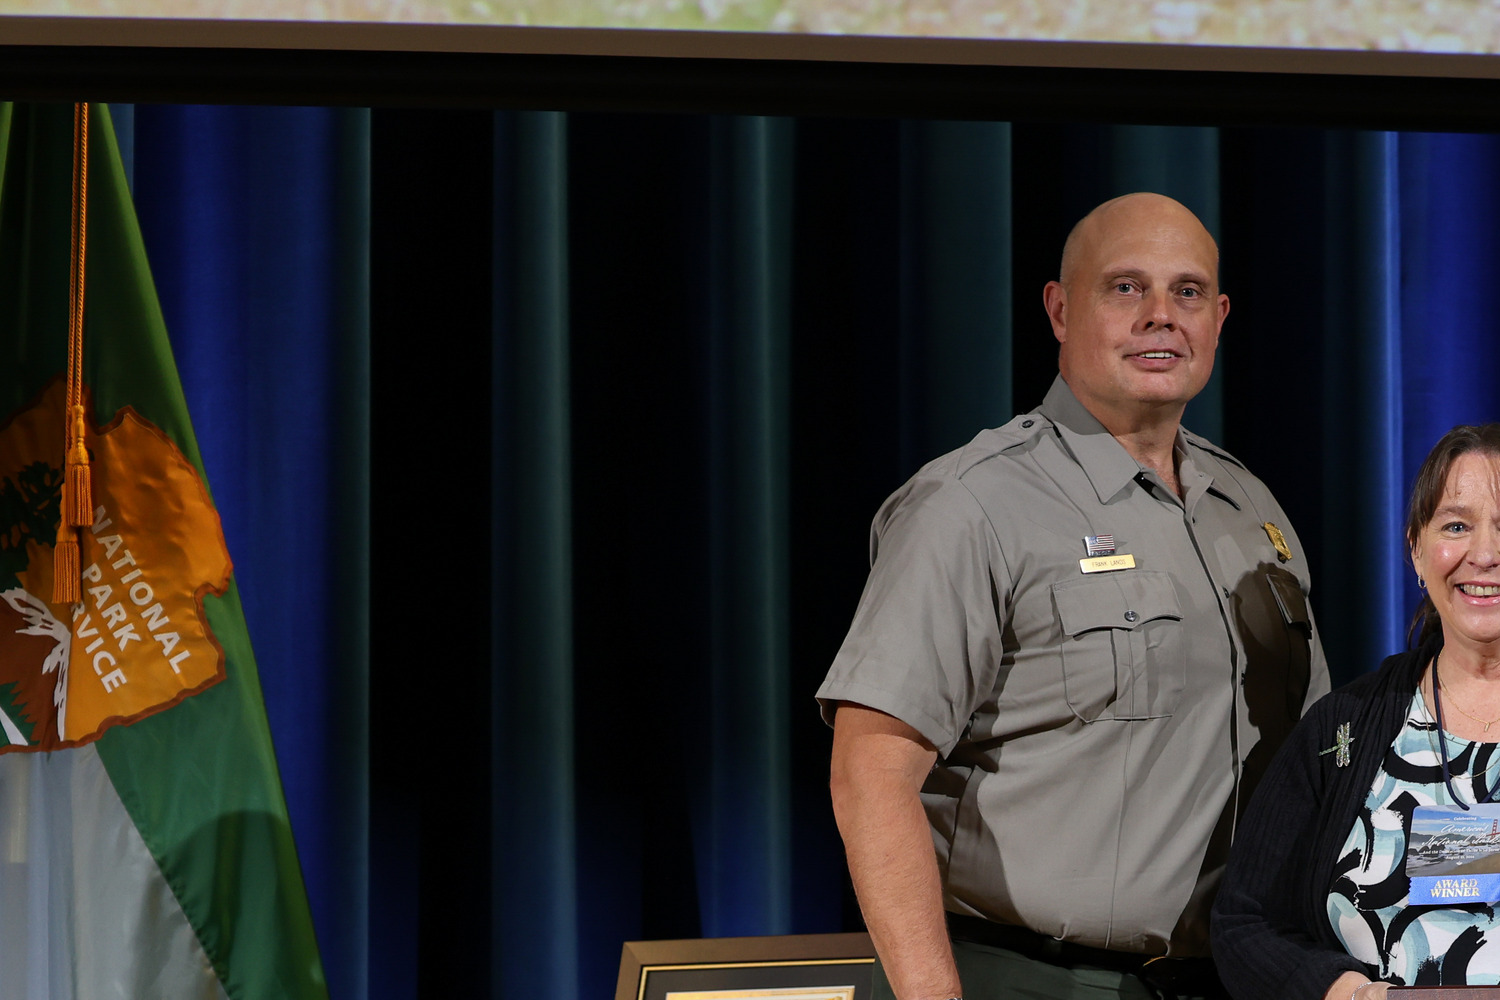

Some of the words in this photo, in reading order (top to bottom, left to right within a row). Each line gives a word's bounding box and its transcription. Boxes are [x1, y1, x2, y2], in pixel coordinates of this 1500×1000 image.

[81, 562, 142, 652] PARK
[91, 504, 191, 675] NATIONAL
[71, 600, 128, 694] RVICE
[1429, 887, 1480, 898] WINNER
[1433, 879, 1478, 889] AWARD
